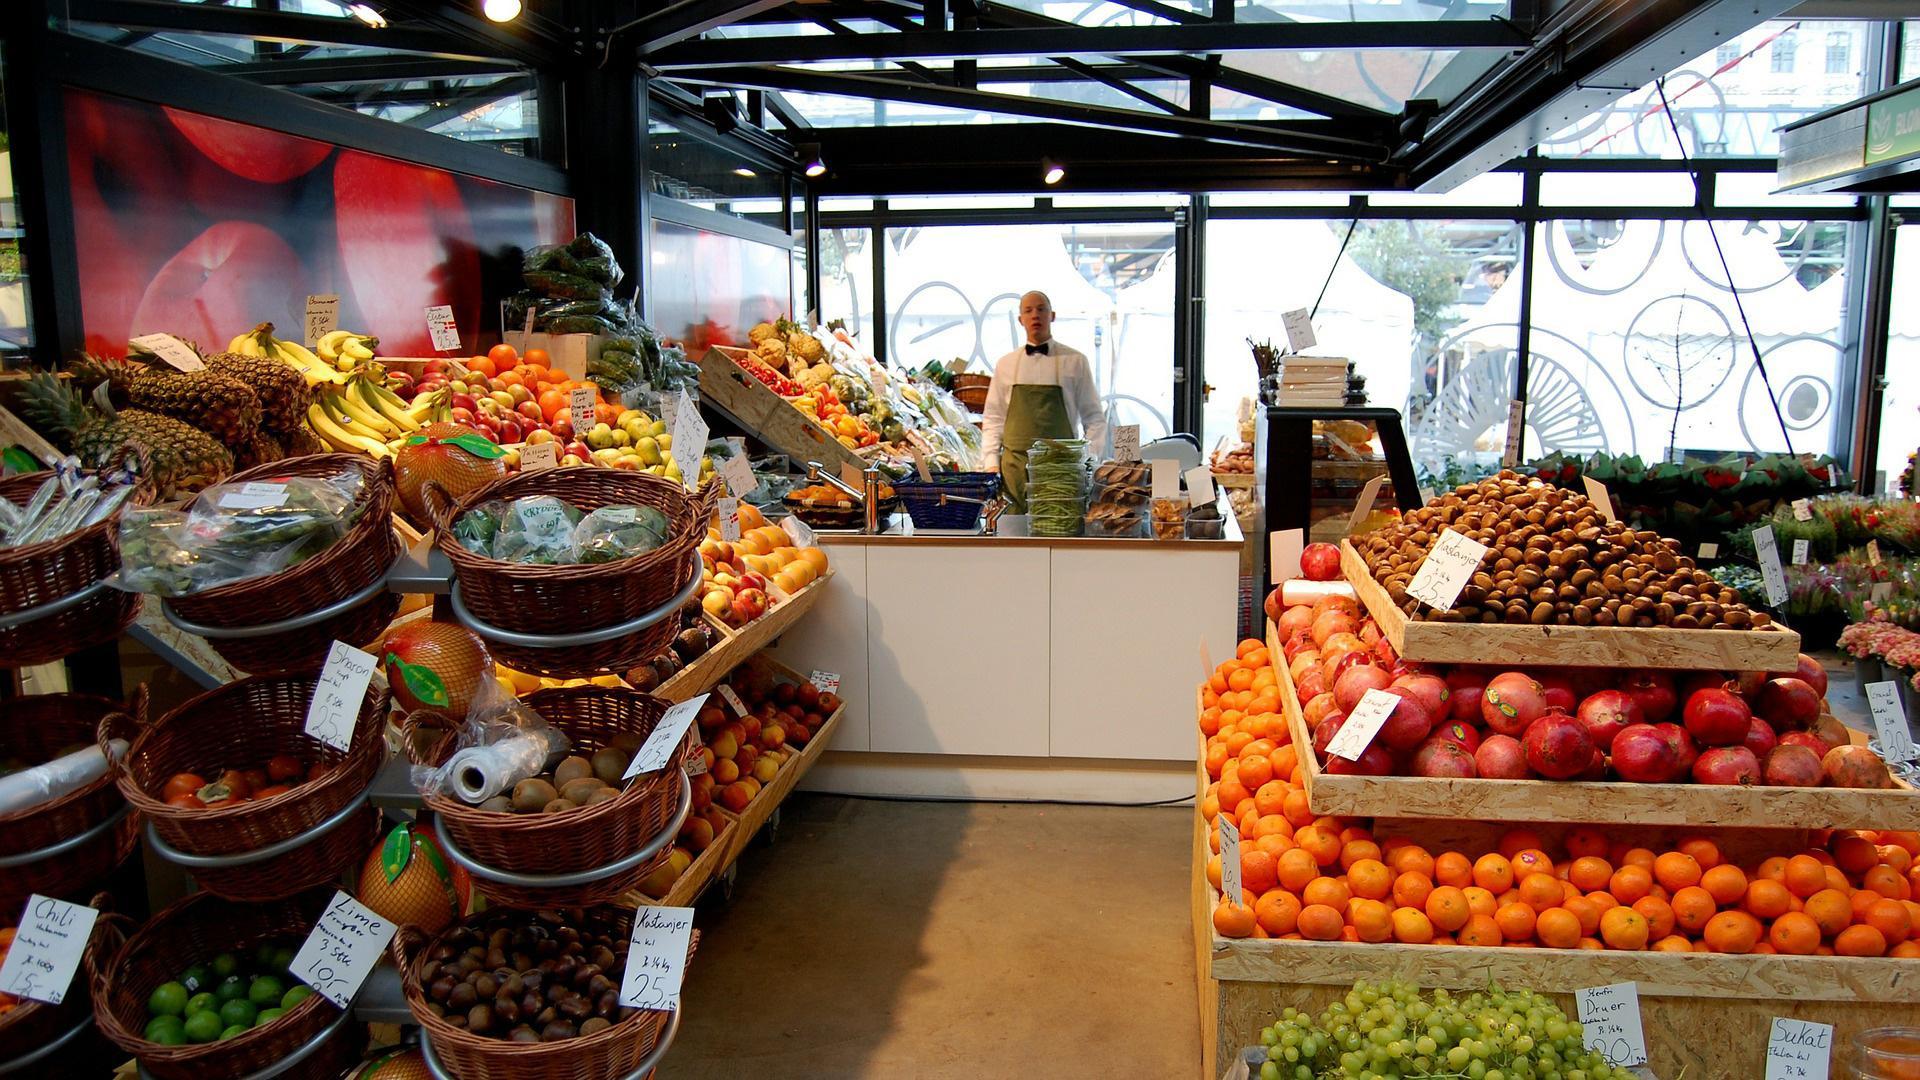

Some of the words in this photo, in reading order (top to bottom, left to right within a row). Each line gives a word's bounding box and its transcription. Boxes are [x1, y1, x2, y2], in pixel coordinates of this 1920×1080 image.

[330, 644, 369, 676] Sharon
[35, 898, 77, 926] Chili
[335, 898, 381, 936] Lime
[637, 908, 688, 934] Kastanjer
[320, 938, 329, 951] 3
[37, 959, 54, 973] 100g
[1585, 998, 1626, 1016] Druer
[1771, 1018, 1827, 1048] Sukat
